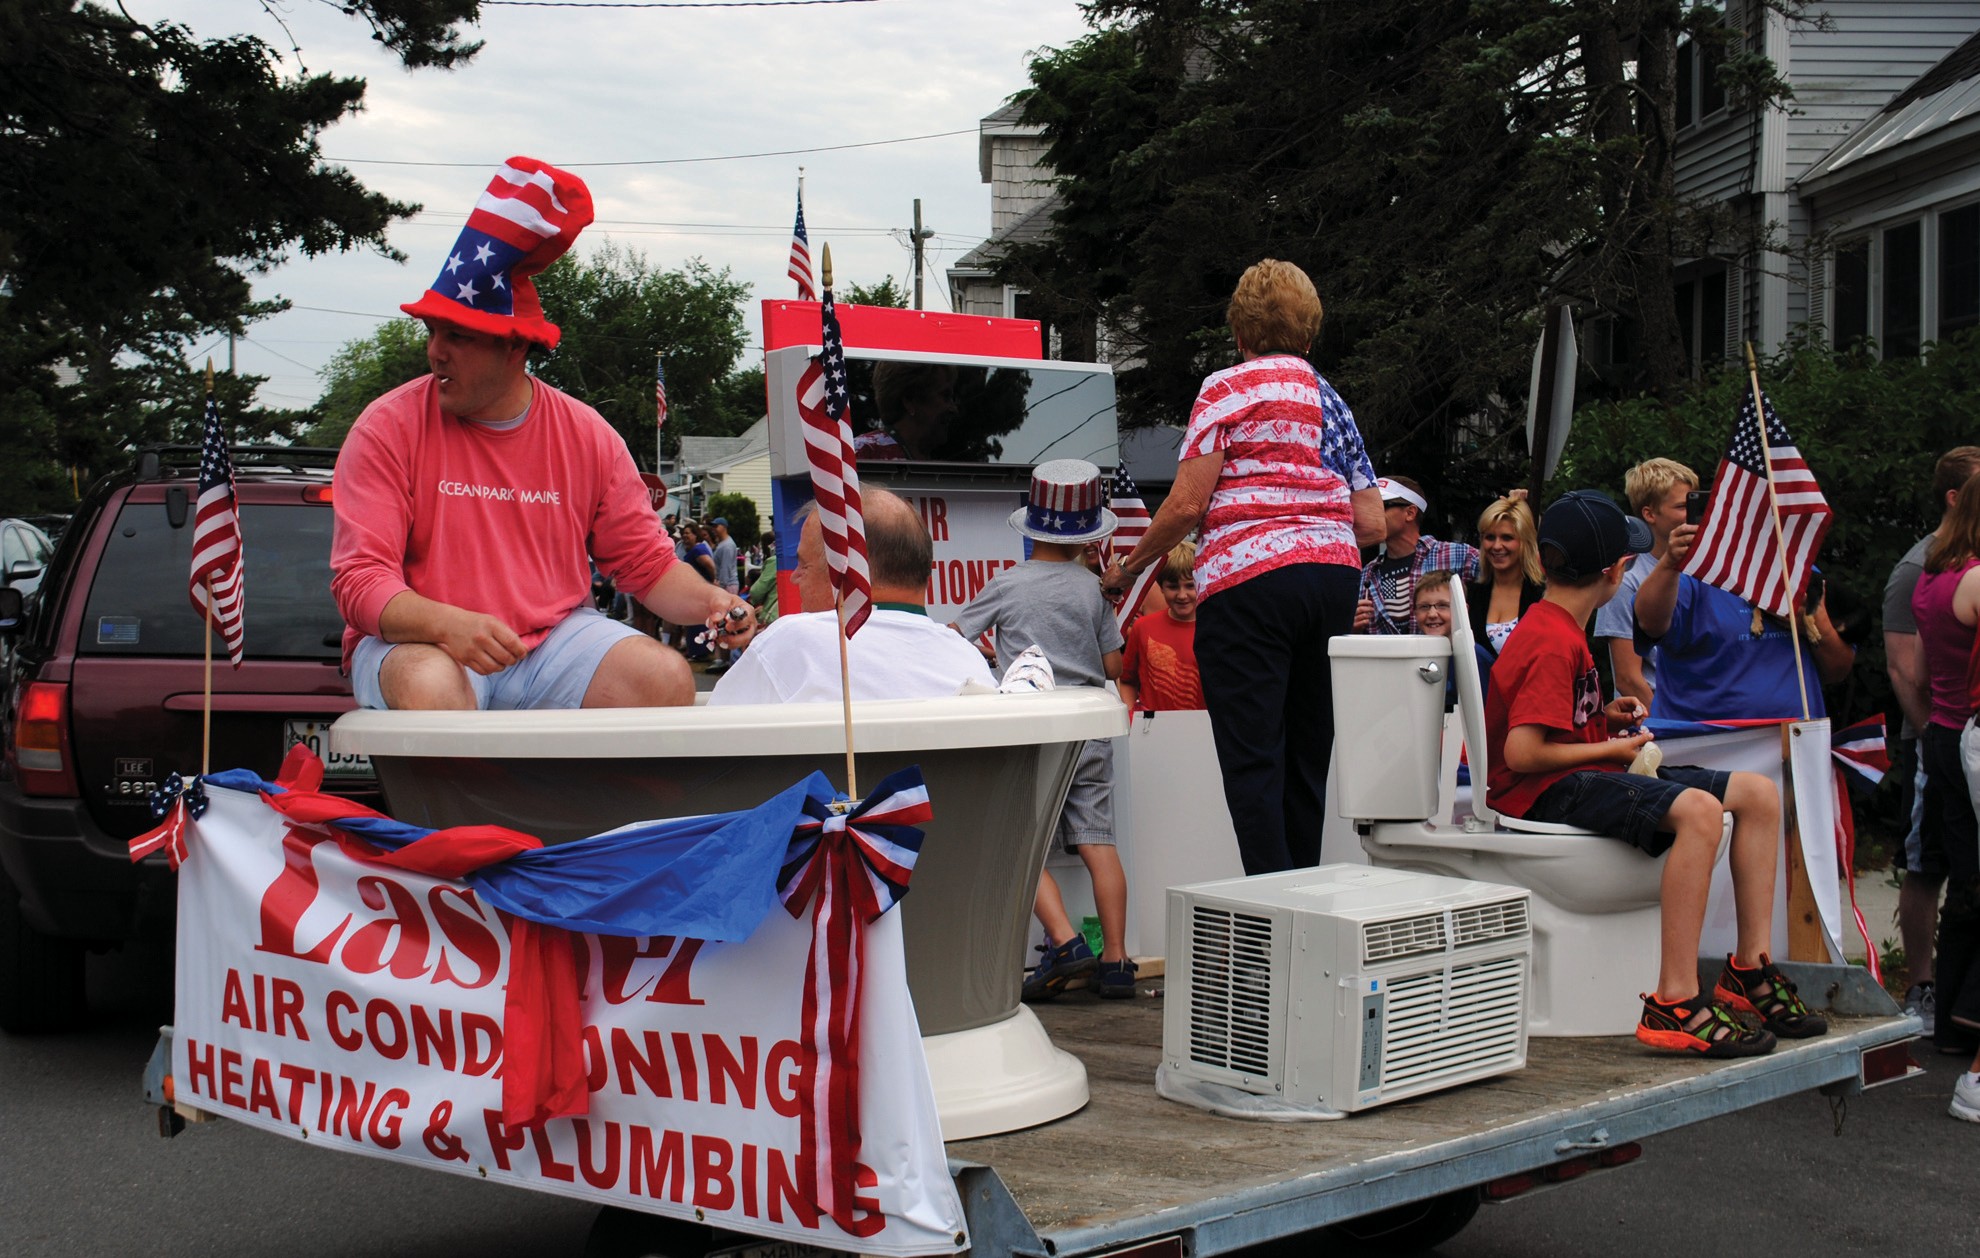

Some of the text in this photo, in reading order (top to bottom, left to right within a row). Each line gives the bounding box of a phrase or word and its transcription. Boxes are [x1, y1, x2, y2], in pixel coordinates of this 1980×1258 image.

[520, 489, 561, 505] MAINE
[648, 487, 664, 503] OP
[903, 496, 949, 541] IR
[124, 763, 145, 774] LEE
[103, 777, 158, 798] Jeep
[253, 820, 722, 1006] Laser
[221, 967, 803, 1119] AIR CONDNING
[187, 1038, 410, 1150] HEATING
[422, 1099, 471, 1163] &
